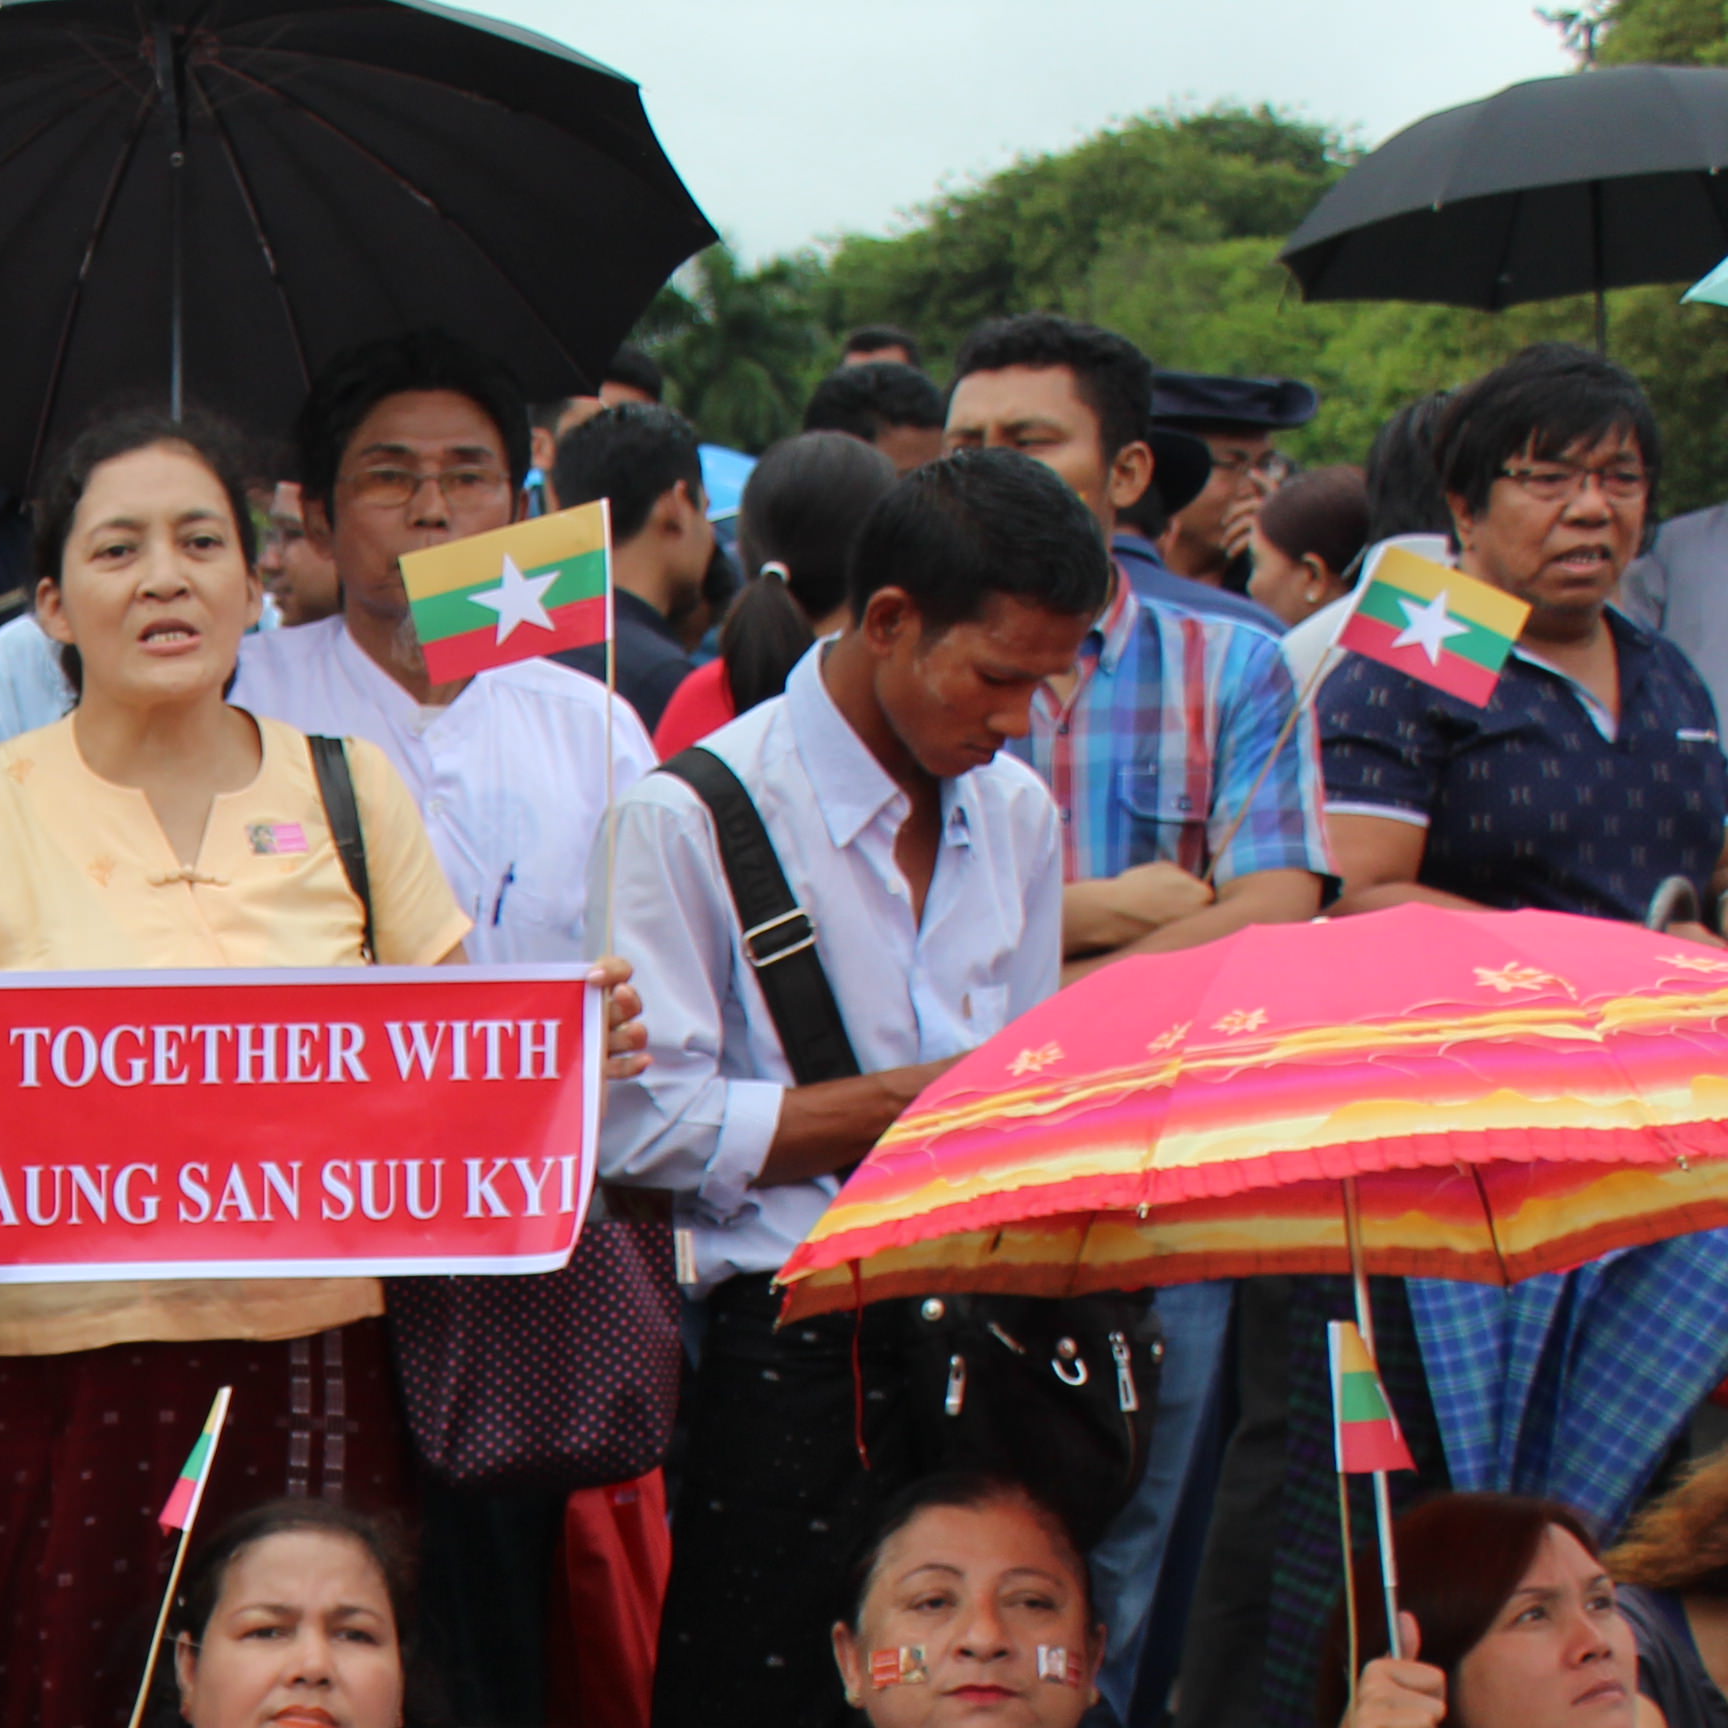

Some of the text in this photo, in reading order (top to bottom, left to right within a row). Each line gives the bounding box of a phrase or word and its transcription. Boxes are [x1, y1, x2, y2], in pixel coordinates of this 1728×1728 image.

[11, 1020, 560, 1086] TOGETHER WITH
[180, 1162, 301, 1222] SAN
[323, 1160, 443, 1220] SUU
[467, 1154, 577, 1216] KYI
